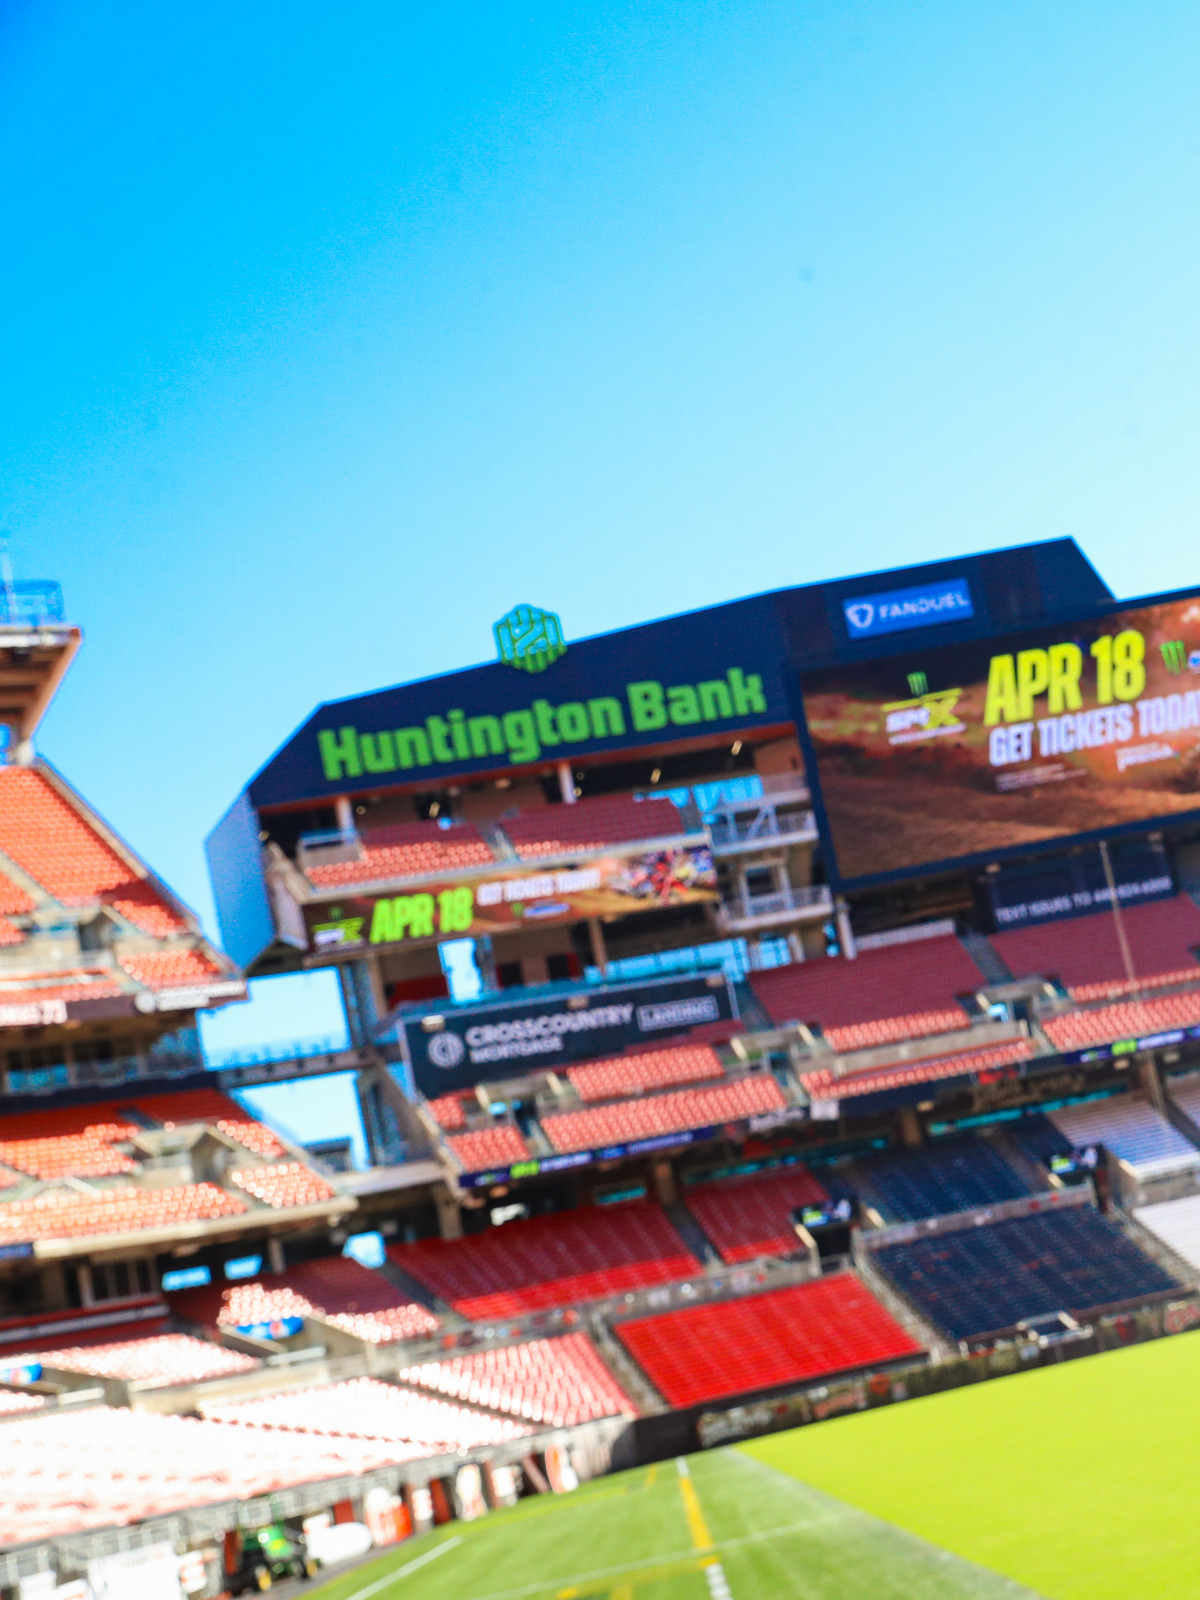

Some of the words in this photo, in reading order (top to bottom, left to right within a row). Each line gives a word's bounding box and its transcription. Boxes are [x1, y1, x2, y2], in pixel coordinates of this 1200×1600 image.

[878, 592, 969, 620] FANDUEL
[984, 643, 1083, 726] APR
[1091, 630, 1145, 704] 18
[320, 696, 624, 779] Huntington
[628, 668, 765, 731] Bank
[989, 721, 1035, 767] GET
[1037, 703, 1134, 757] TICKETS
[369, 893, 435, 944] APR
[436, 887, 474, 933] 18
[464, 1001, 635, 1047] CROSSCOUNTRY
[469, 1033, 564, 1065] MORTGAGE
